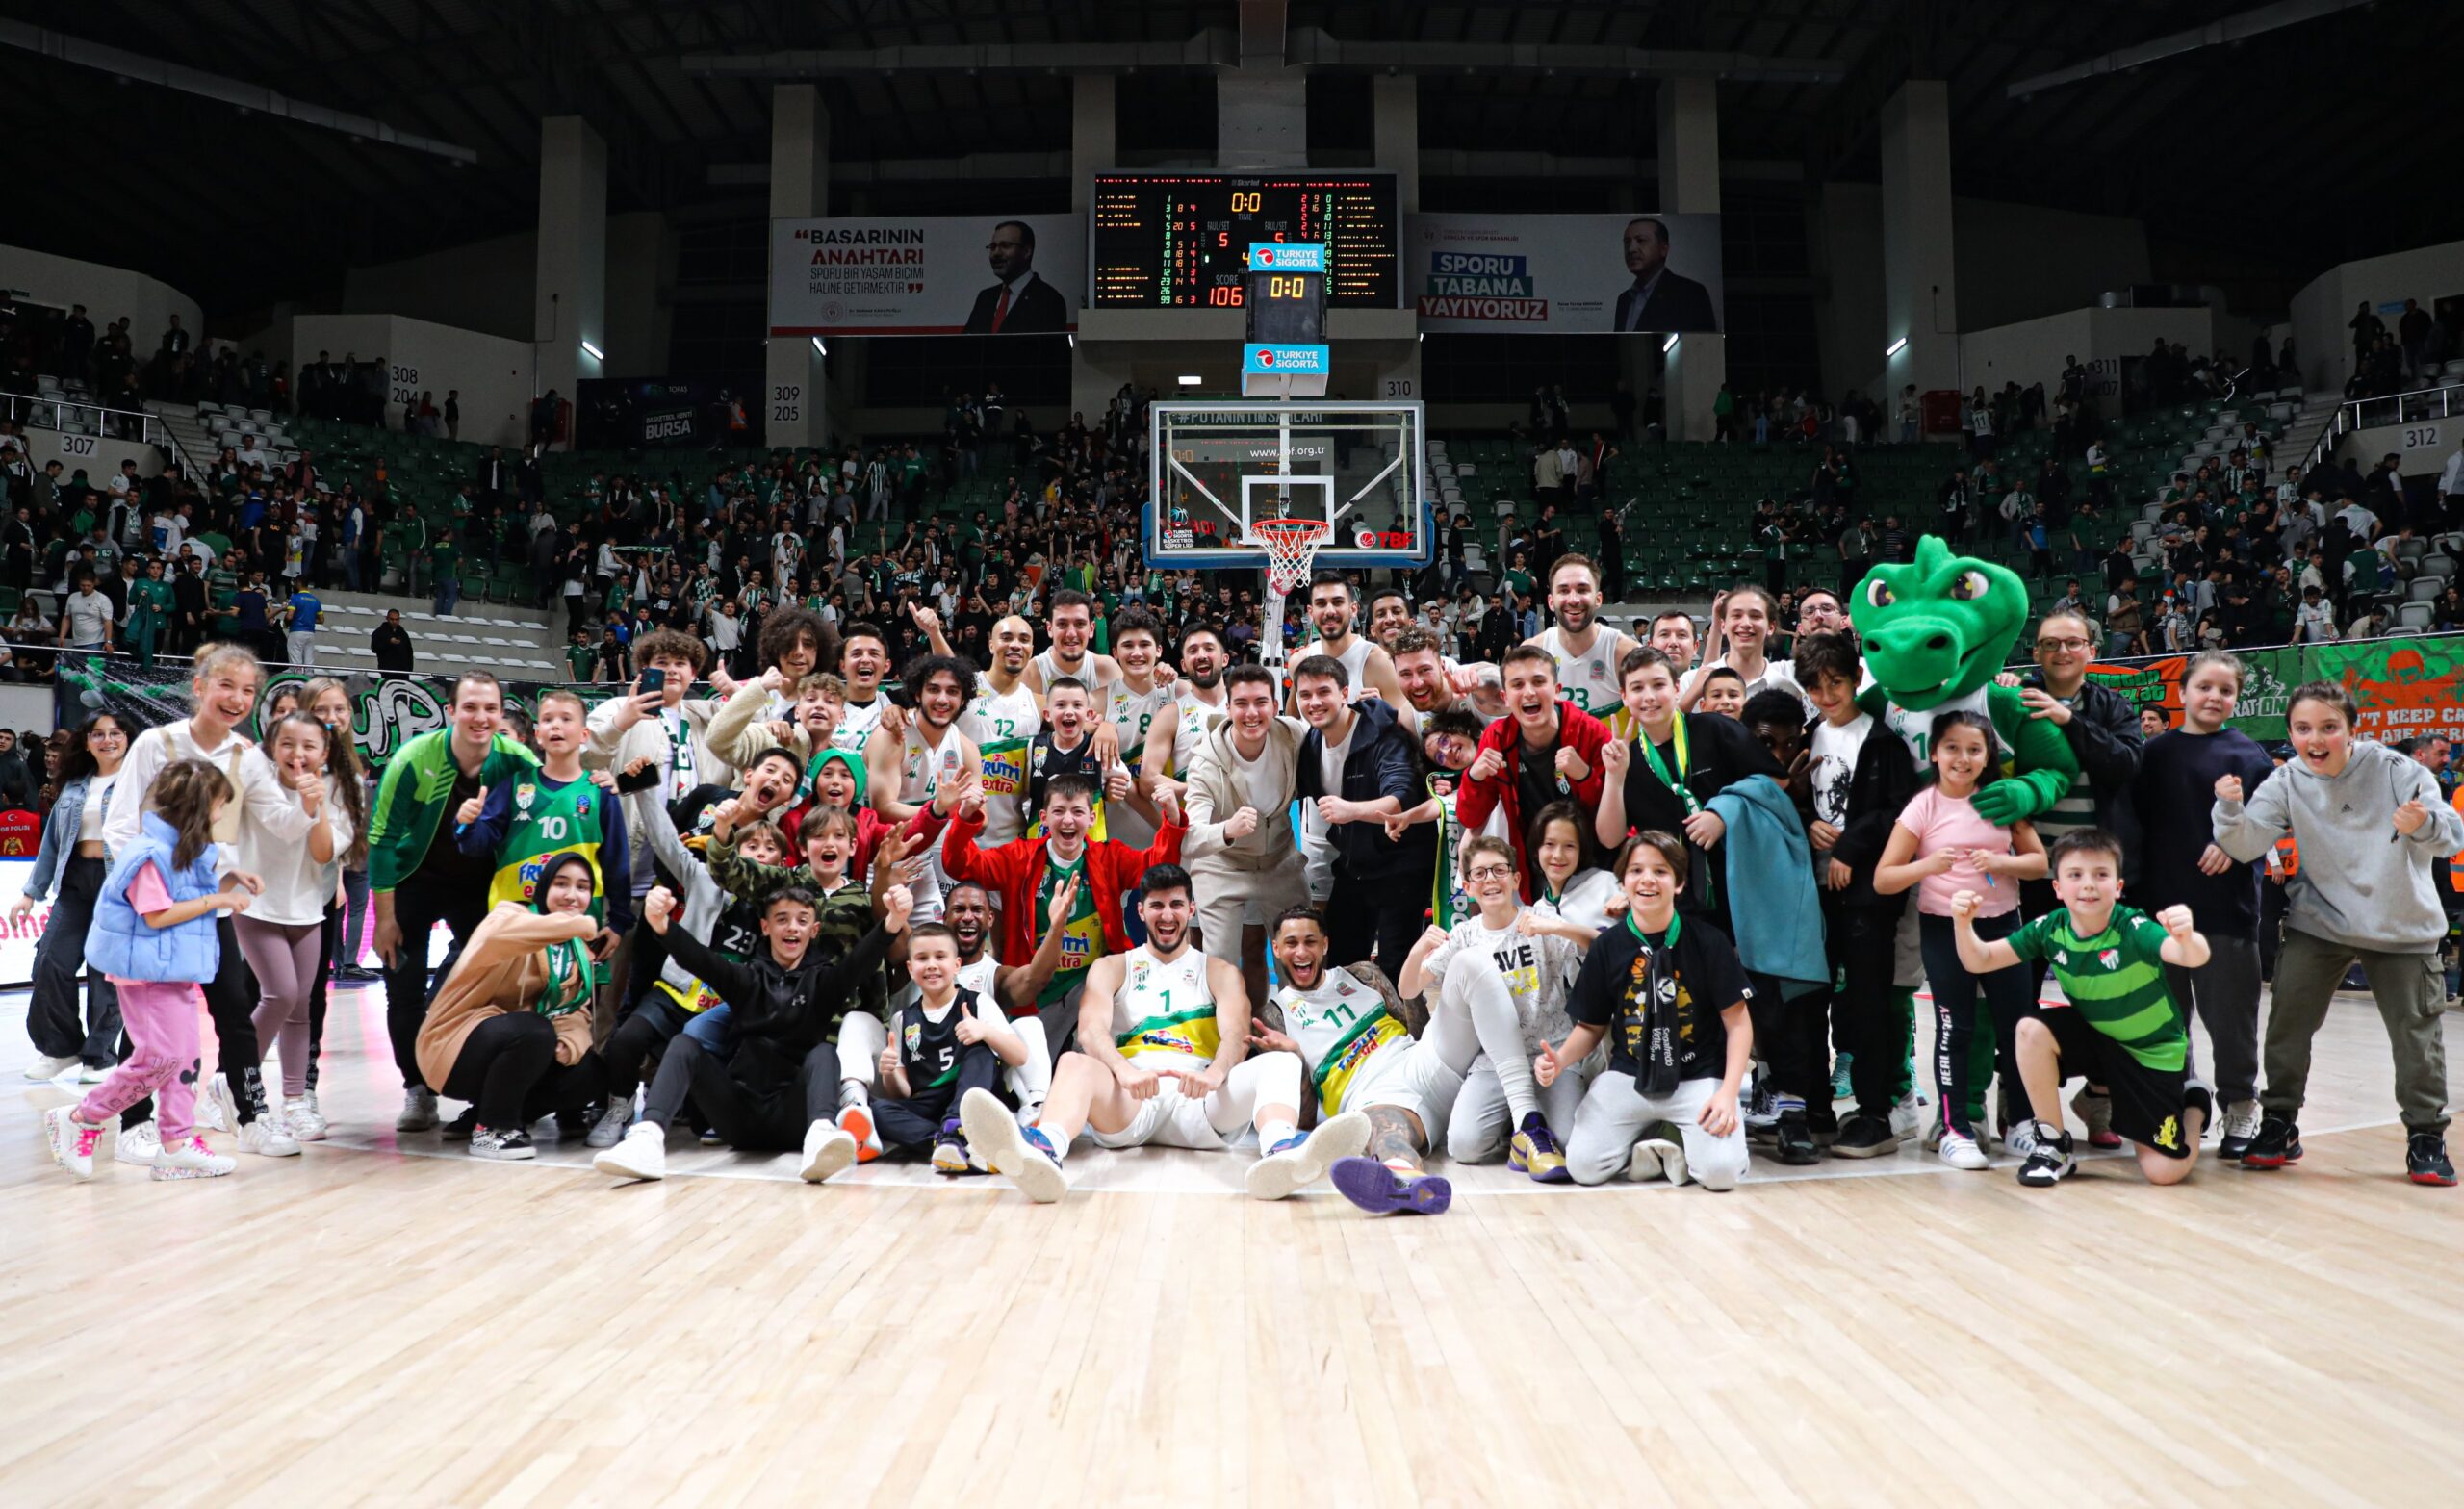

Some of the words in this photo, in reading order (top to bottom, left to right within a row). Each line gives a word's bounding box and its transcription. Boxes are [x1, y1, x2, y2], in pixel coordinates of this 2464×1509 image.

[1232, 193, 1261, 212] 0:0
[1325, 194, 1332, 203] 0
[1207, 221, 1230, 231] FAUL/SET
[1265, 221, 1288, 231] FAUL/SET
[1301, 213, 1307, 221] 2
[1324, 213, 1332, 221] 10
[1173, 222, 1184, 231] 20
[1324, 231, 1332, 240] 13
[1219, 232, 1228, 247] 5
[811, 249, 924, 265] ANAHTARI
[1176, 259, 1184, 268] 18
[1439, 254, 1515, 275] SPORU
[810, 268, 841, 280] SPORU
[1161, 277, 1171, 286] 23
[1215, 274, 1239, 285] SCORE
[1270, 277, 1304, 297] 0:0
[1433, 277, 1526, 296] TABANA
[1210, 287, 1243, 305] 106
[1421, 296, 1544, 320] YAYIYORUZ
[392, 367, 418, 385] 308
[774, 387, 800, 401] 309
[1388, 381, 1411, 396] 310
[2098, 381, 2118, 396] 07
[774, 406, 799, 421] 205
[1974, 416, 1987, 426] 11
[645, 419, 692, 440] BURSA
[2406, 428, 2436, 447] 312
[63, 436, 94, 455] 307
[1376, 531, 1414, 549] TBF
[1561, 687, 1589, 711] 23
[1139, 713, 1151, 735] 8
[2387, 708, 2436, 726] KEEP
[994, 718, 1015, 739] 12
[856, 730, 872, 751] 2
[925, 776, 936, 795] 4
[537, 816, 567, 840] 10
[723, 925, 757, 955] 23
[1159, 989, 1170, 1012] 1
[1322, 1003, 1357, 1028] 11
[1652, 1028, 1661, 1051] Virtus
[1662, 1027, 1673, 1067] Segafredo
[938, 1047, 954, 1072] 5
[1939, 1055, 1952, 1086] REAL
